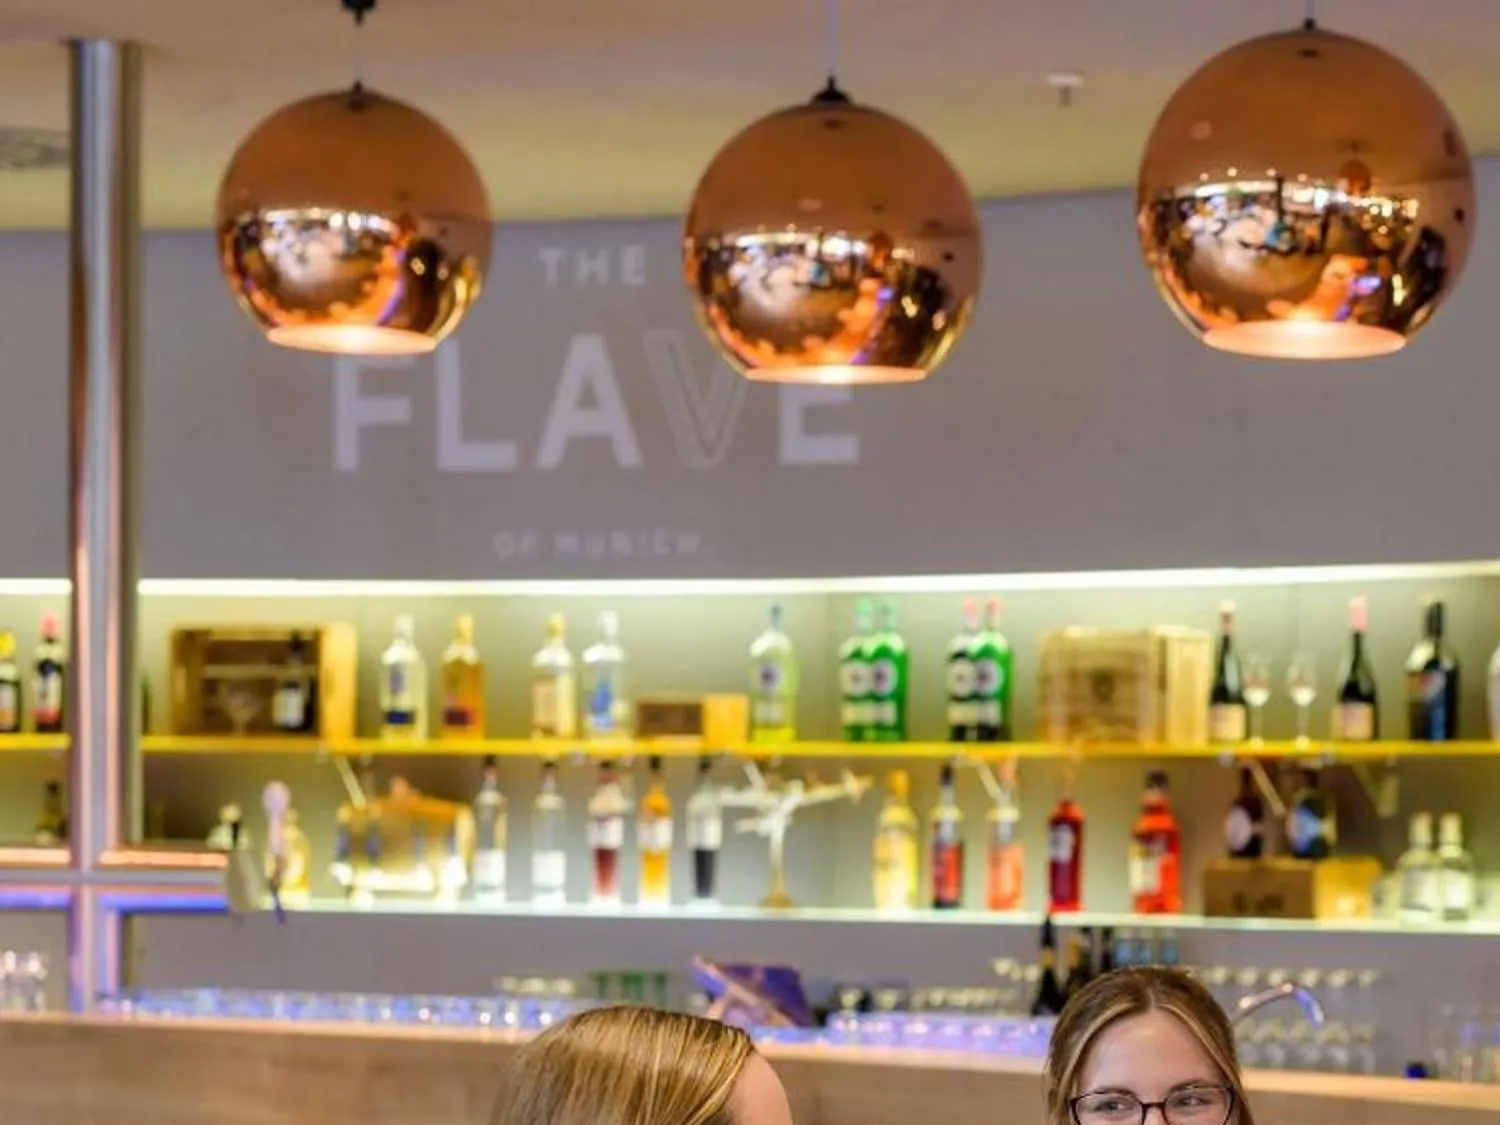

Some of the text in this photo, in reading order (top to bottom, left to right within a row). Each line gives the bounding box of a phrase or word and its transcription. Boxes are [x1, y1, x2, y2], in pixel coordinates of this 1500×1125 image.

[538, 247, 648, 285] THE
[333, 330, 861, 472] FLAVE
[493, 529, 701, 558] OF MUNICH
